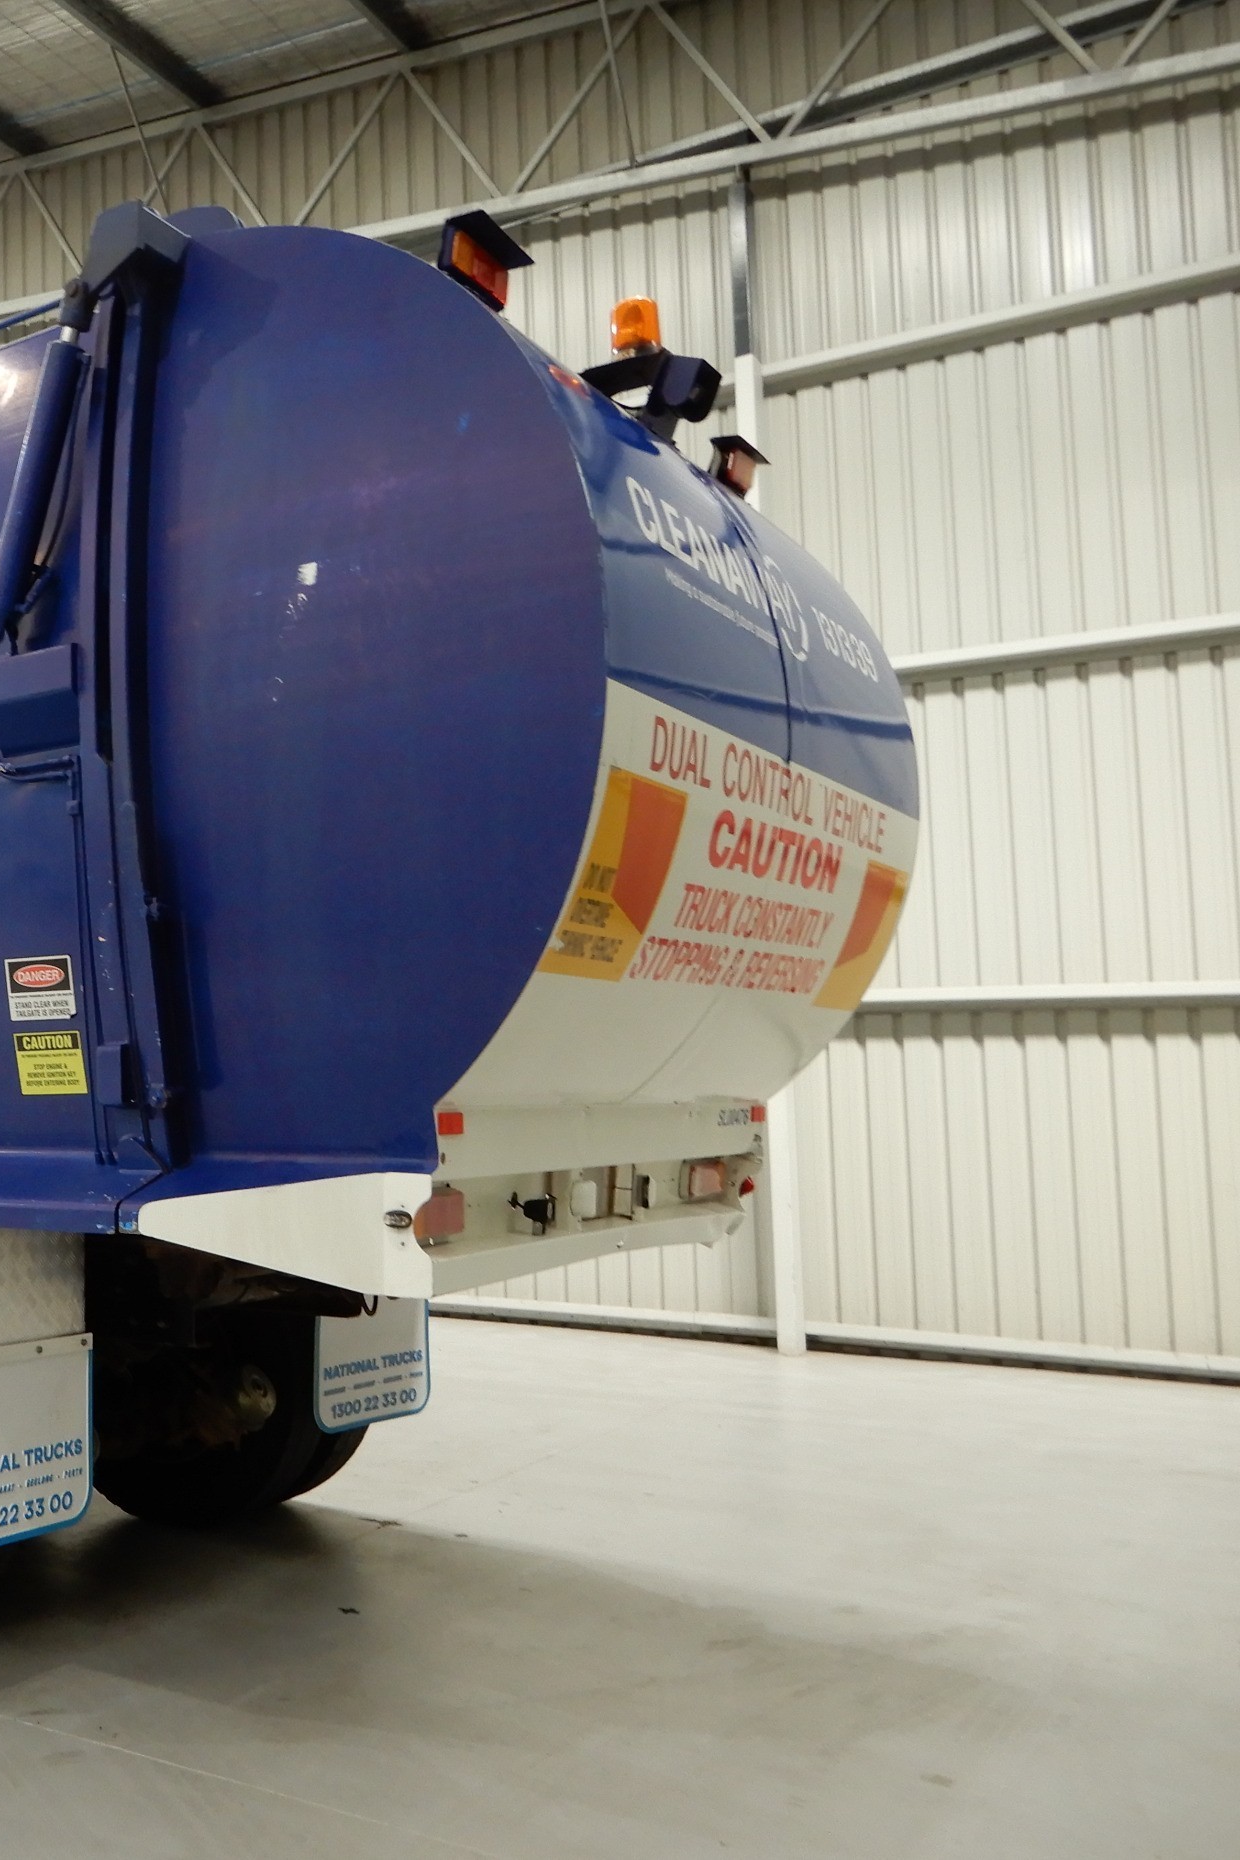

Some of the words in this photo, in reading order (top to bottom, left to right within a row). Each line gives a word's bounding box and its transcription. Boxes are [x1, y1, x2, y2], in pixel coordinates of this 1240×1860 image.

[626, 476, 797, 632] CLEANAWAY
[650, 715, 710, 788] DUAL
[723, 743, 813, 826] CONTROL
[820, 784, 886, 853] VEHICLE
[708, 809, 842, 894] CAUTION
[674, 883, 740, 935] TRUCK
[733, 895, 835, 948] CONSTANTLY
[17, 970, 60, 983] DANGER
[628, 936, 729, 986] STOPPING
[15, 1001, 32, 1009] STAND
[34, 1000, 51, 1008] CLEAR
[53, 999, 69, 1007] WHEN
[16, 1009, 40, 1017] TAILGATE
[22, 1034, 72, 1050] CAUTION
[323, 1359, 379, 1381] NATIONAL
[381, 1350, 423, 1368] TRUCKS
[331, 1399, 361, 1419] 1300
[364, 1395, 379, 1411] 22
[382, 1392, 397, 1408] 33
[400, 1388, 416, 1404] 00
[23, 1439, 83, 1467] TRUCKS
[24, 1498, 45, 1520] 33
[49, 1490, 73, 1513] 00
